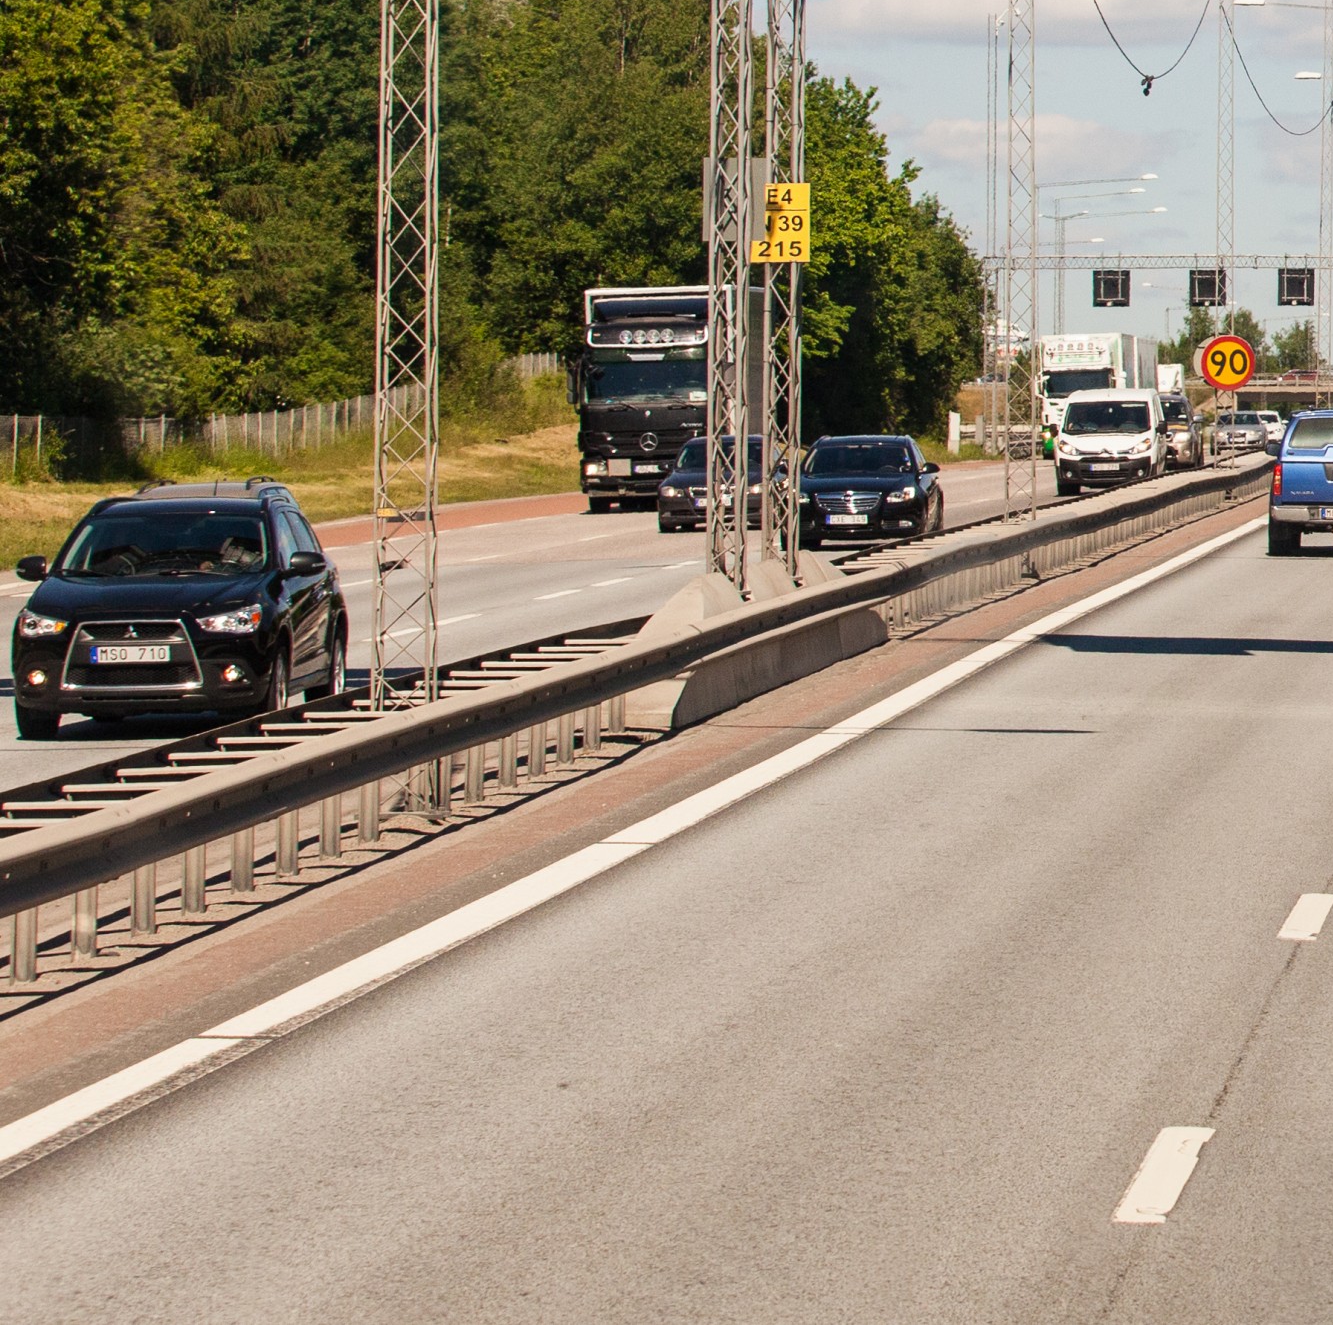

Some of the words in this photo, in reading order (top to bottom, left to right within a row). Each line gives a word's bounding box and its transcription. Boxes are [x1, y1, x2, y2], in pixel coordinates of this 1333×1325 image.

[767, 188, 792, 205] E4
[778, 215, 803, 232] 39
[758, 240, 802, 257] 215
[1211, 349, 1248, 377] 90
[100, 648, 128, 660] MSO
[138, 648, 166, 660] 710
